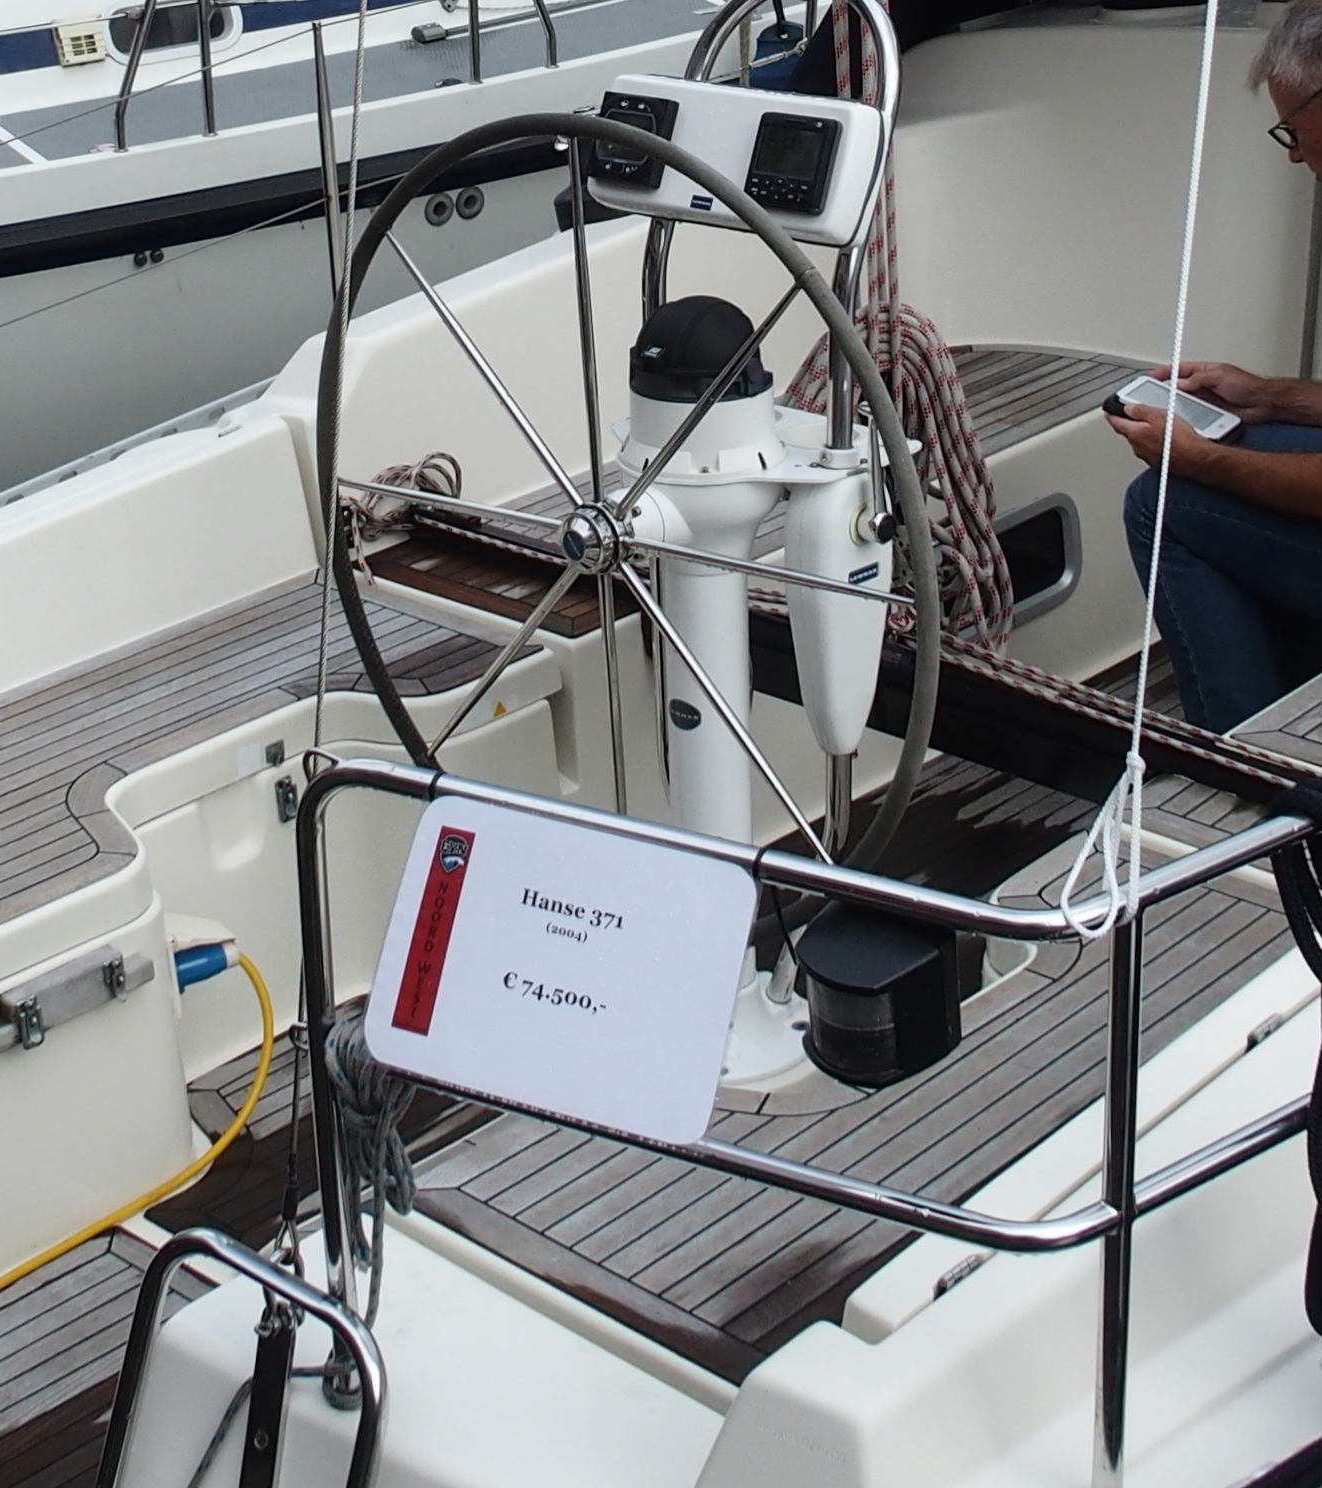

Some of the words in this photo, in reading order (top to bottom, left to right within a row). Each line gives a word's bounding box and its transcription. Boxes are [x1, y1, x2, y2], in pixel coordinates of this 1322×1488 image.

[521, 887, 585, 919] Hanse
[589, 909, 623, 929] 371
[546, 922, 588, 943] (2004)
[503, 971, 518, 989] €
[521, 979, 607, 1015] 74.500,-
